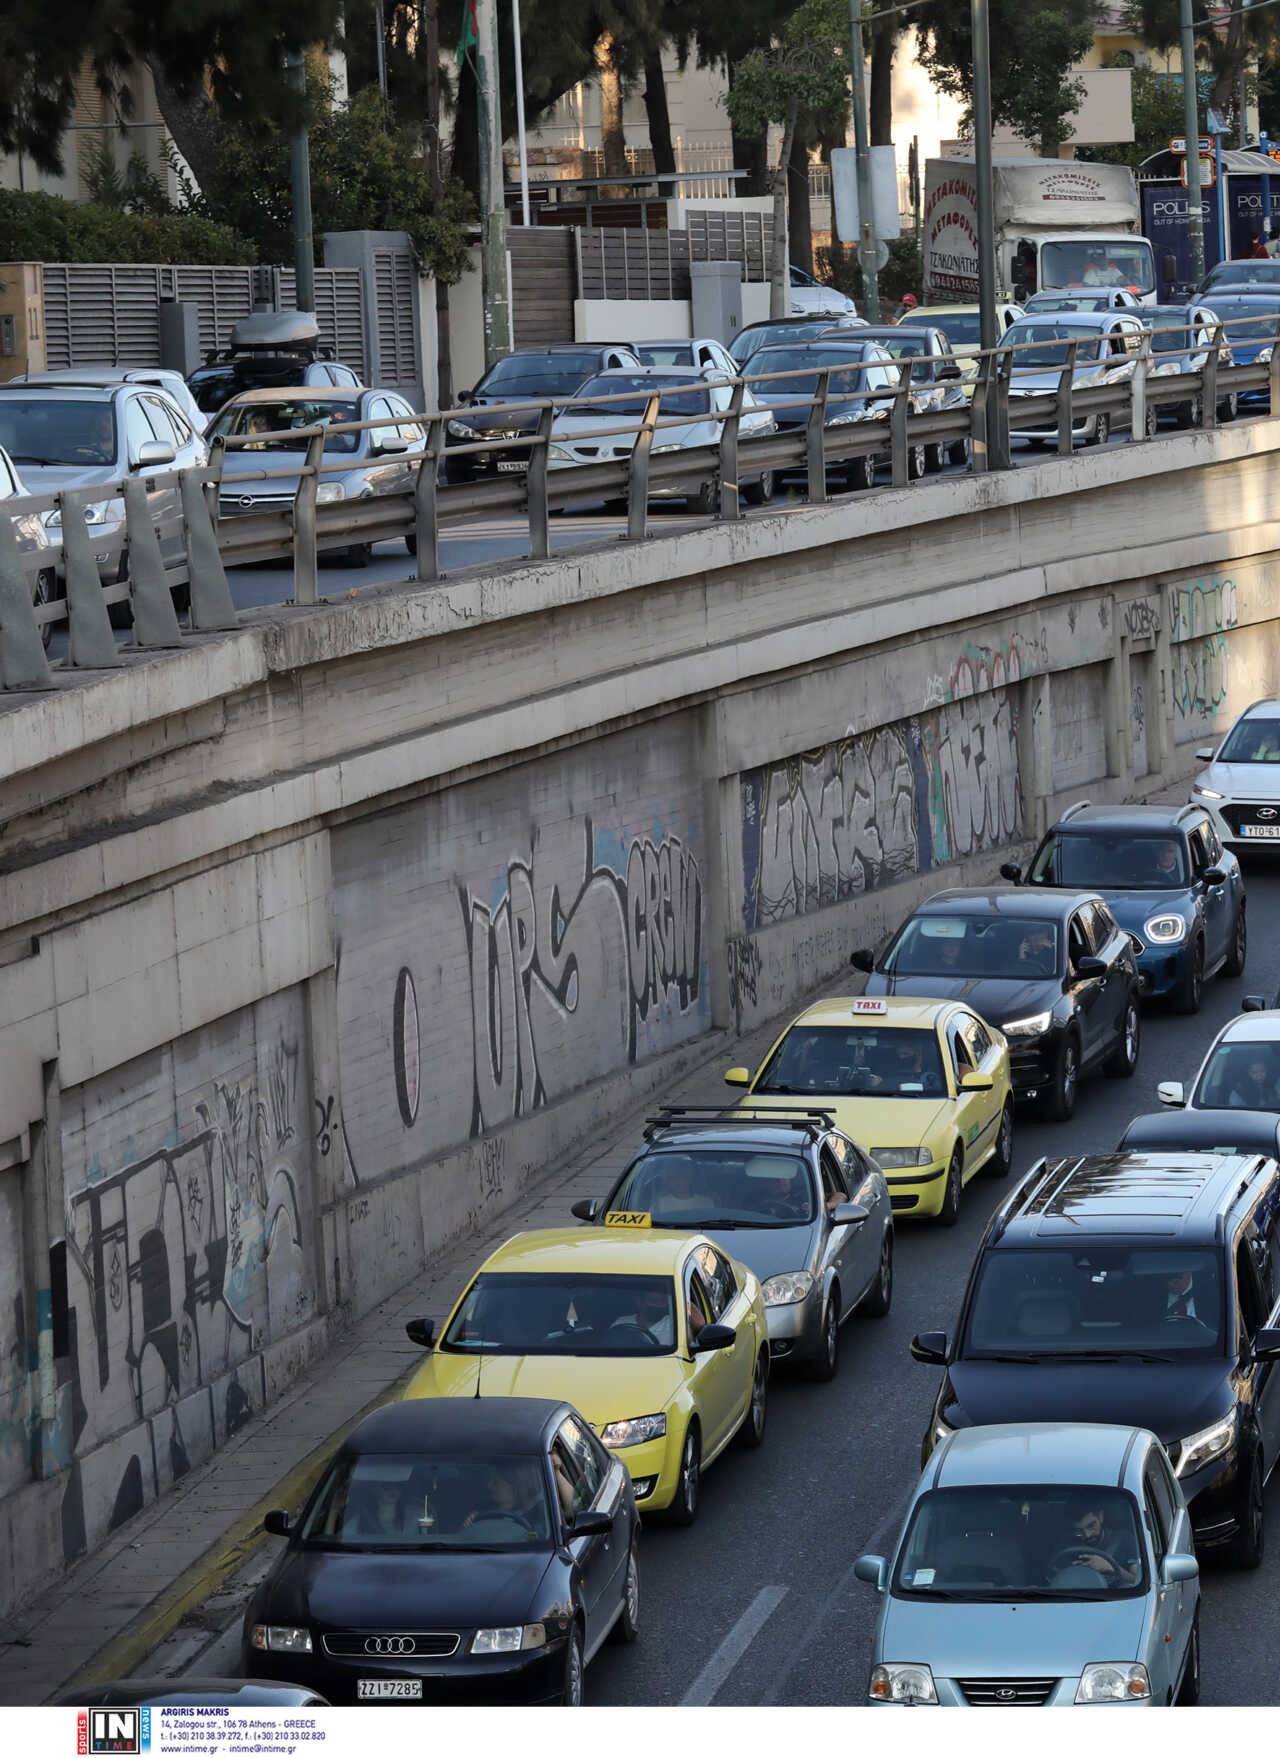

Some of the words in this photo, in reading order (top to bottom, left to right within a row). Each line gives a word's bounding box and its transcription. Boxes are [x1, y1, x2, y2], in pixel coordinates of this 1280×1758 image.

[927, 178, 977, 216] ΜΕΤΑΚΟΜΙΣ
[1153, 200, 1211, 216] POLIS
[856, 1001, 882, 1009] TAXI
[608, 1213, 646, 1225] TAXI
